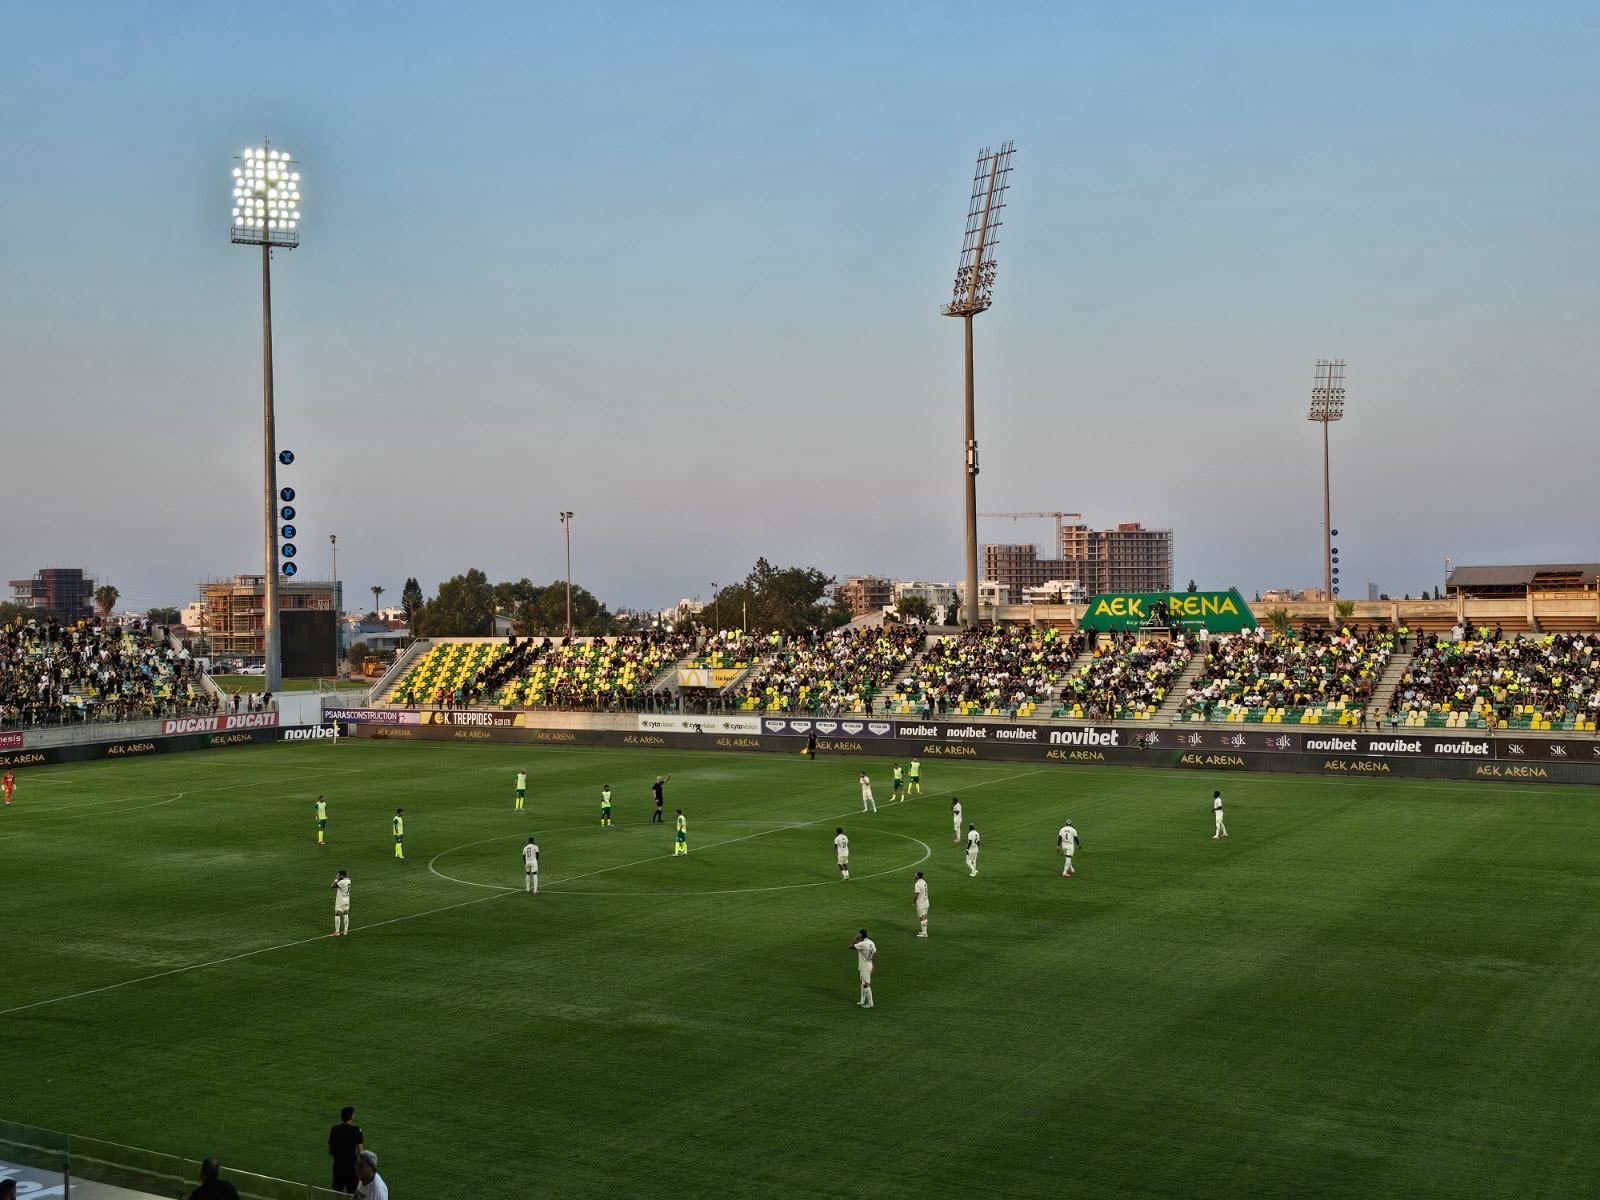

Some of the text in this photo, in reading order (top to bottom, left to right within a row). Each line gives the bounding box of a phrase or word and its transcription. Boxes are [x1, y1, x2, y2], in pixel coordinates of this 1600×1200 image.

[1095, 596, 1239, 617] AEK RENA
[165, 712, 276, 734] DUCATI DUCATI
[453, 712, 493, 726] TREPPIDES
[284, 725, 341, 740] novibet
[899, 725, 939, 737] novibet
[946, 726, 987, 738] novibet
[995, 727, 1038, 740] novibet
[1049, 727, 1120, 746] novibet
[209, 733, 253, 745] AEK ARENA
[623, 735, 665, 745] AEK ARENA
[716, 738, 761, 748] AEK ARENA
[1306, 737, 1358, 751] novibet
[107, 743, 156, 755] AEK ARENA
[815, 741, 863, 752] AEK ARENA
[923, 745, 977, 756] AEK ARENA
[1368, 739, 1422, 753] novibet
[1434, 740, 1489, 755] novibet
[13, 753, 46, 764] ARENA
[1046, 750, 1105, 761] AEK ARENA
[1180, 754, 1245, 766] AEK ARENA
[1324, 760, 1391, 773] AEK ARENA
[1475, 764, 1549, 778] AEK ARENA
